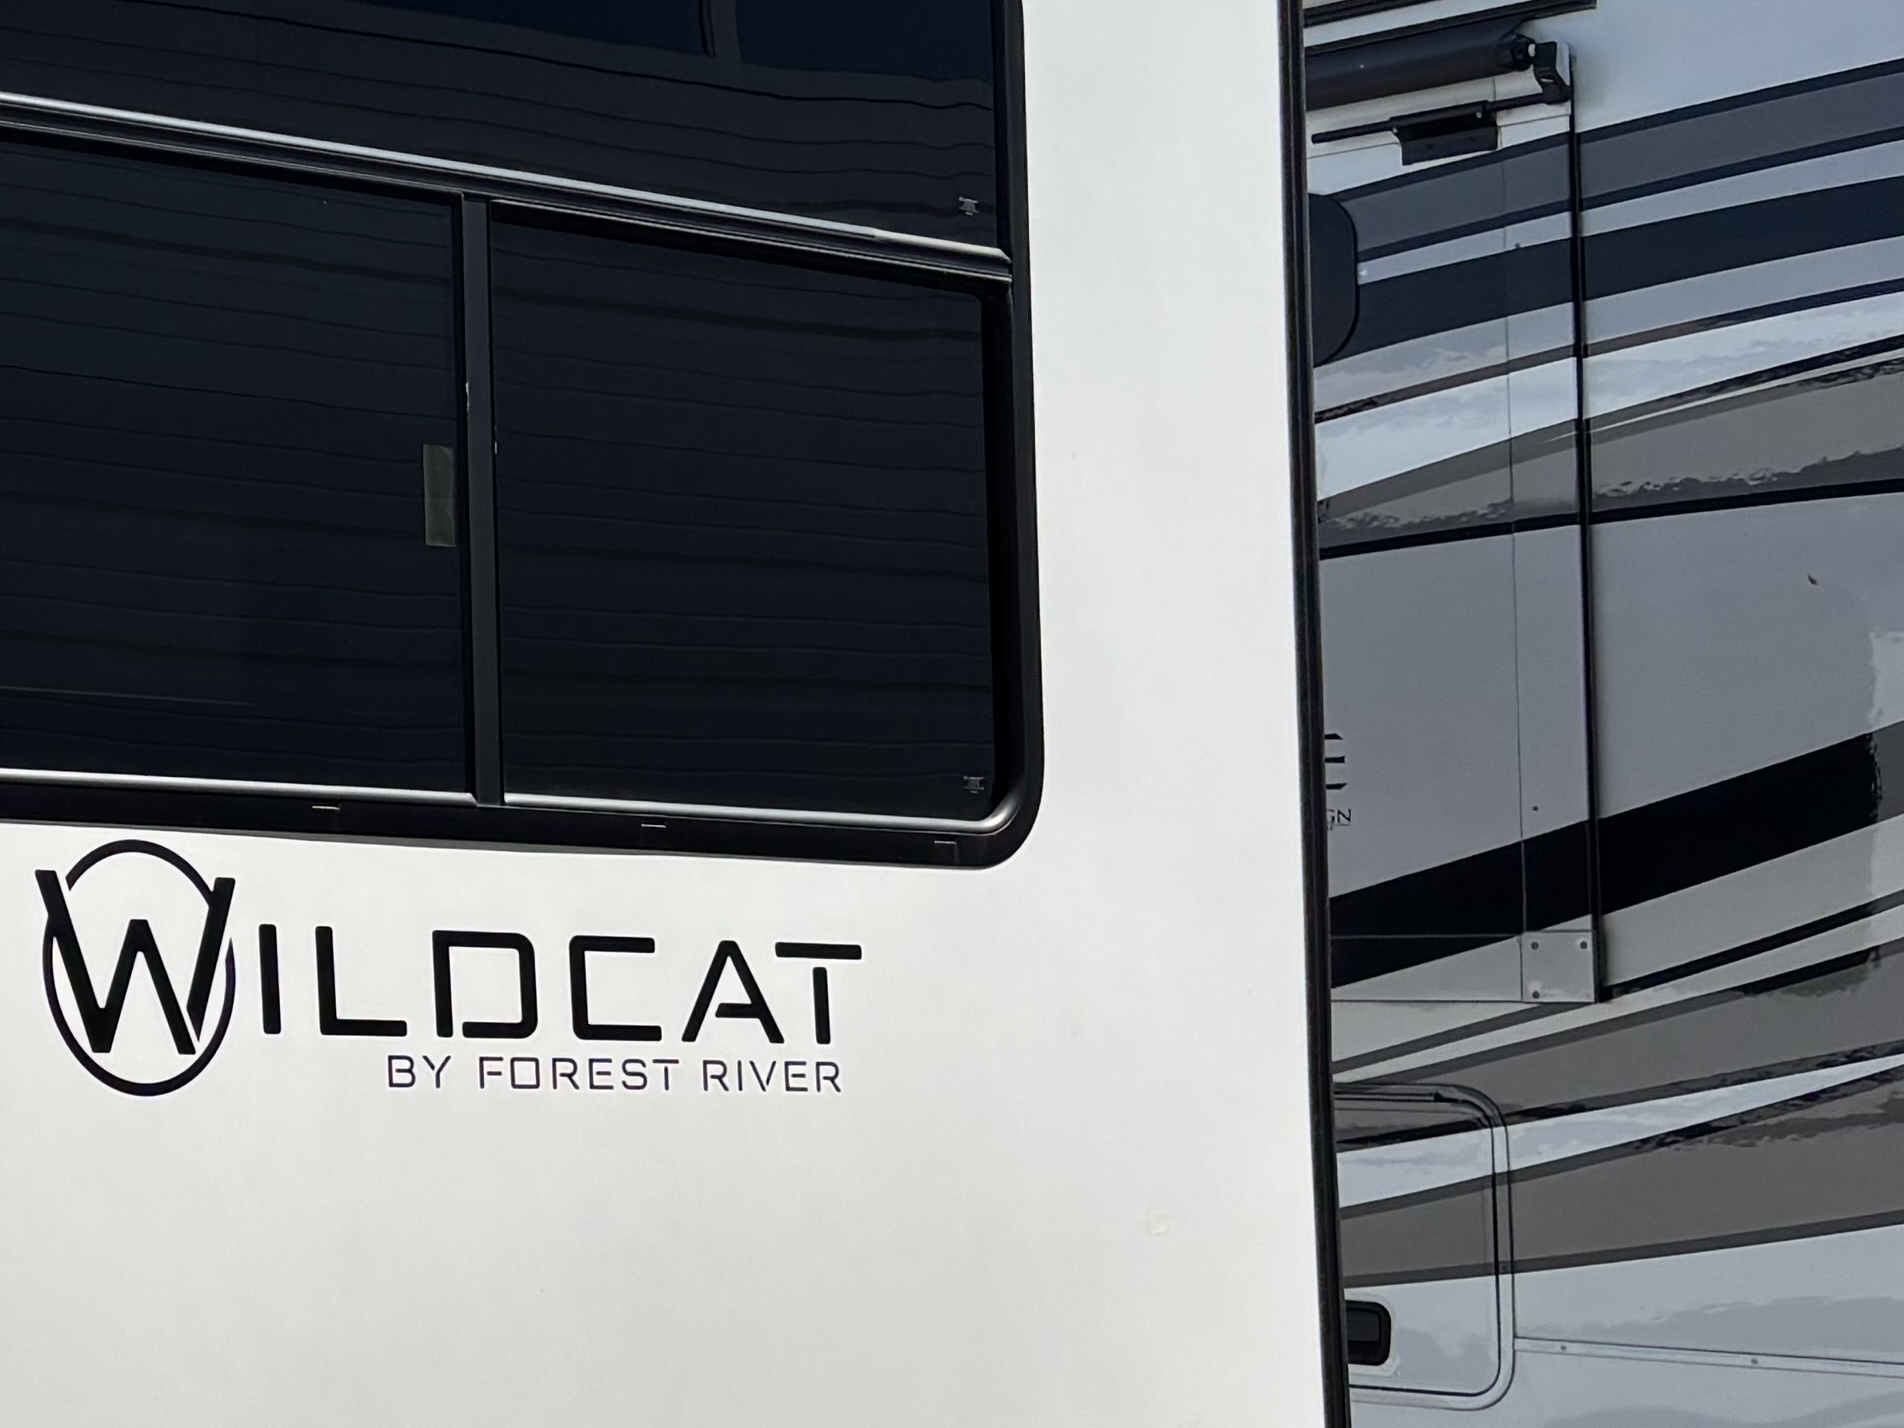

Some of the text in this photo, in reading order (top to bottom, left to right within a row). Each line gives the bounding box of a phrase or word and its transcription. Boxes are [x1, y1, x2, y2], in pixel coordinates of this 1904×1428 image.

[34, 868, 863, 1055] WILDCAT
[388, 1055, 843, 1094] BY FOREST RIVER
